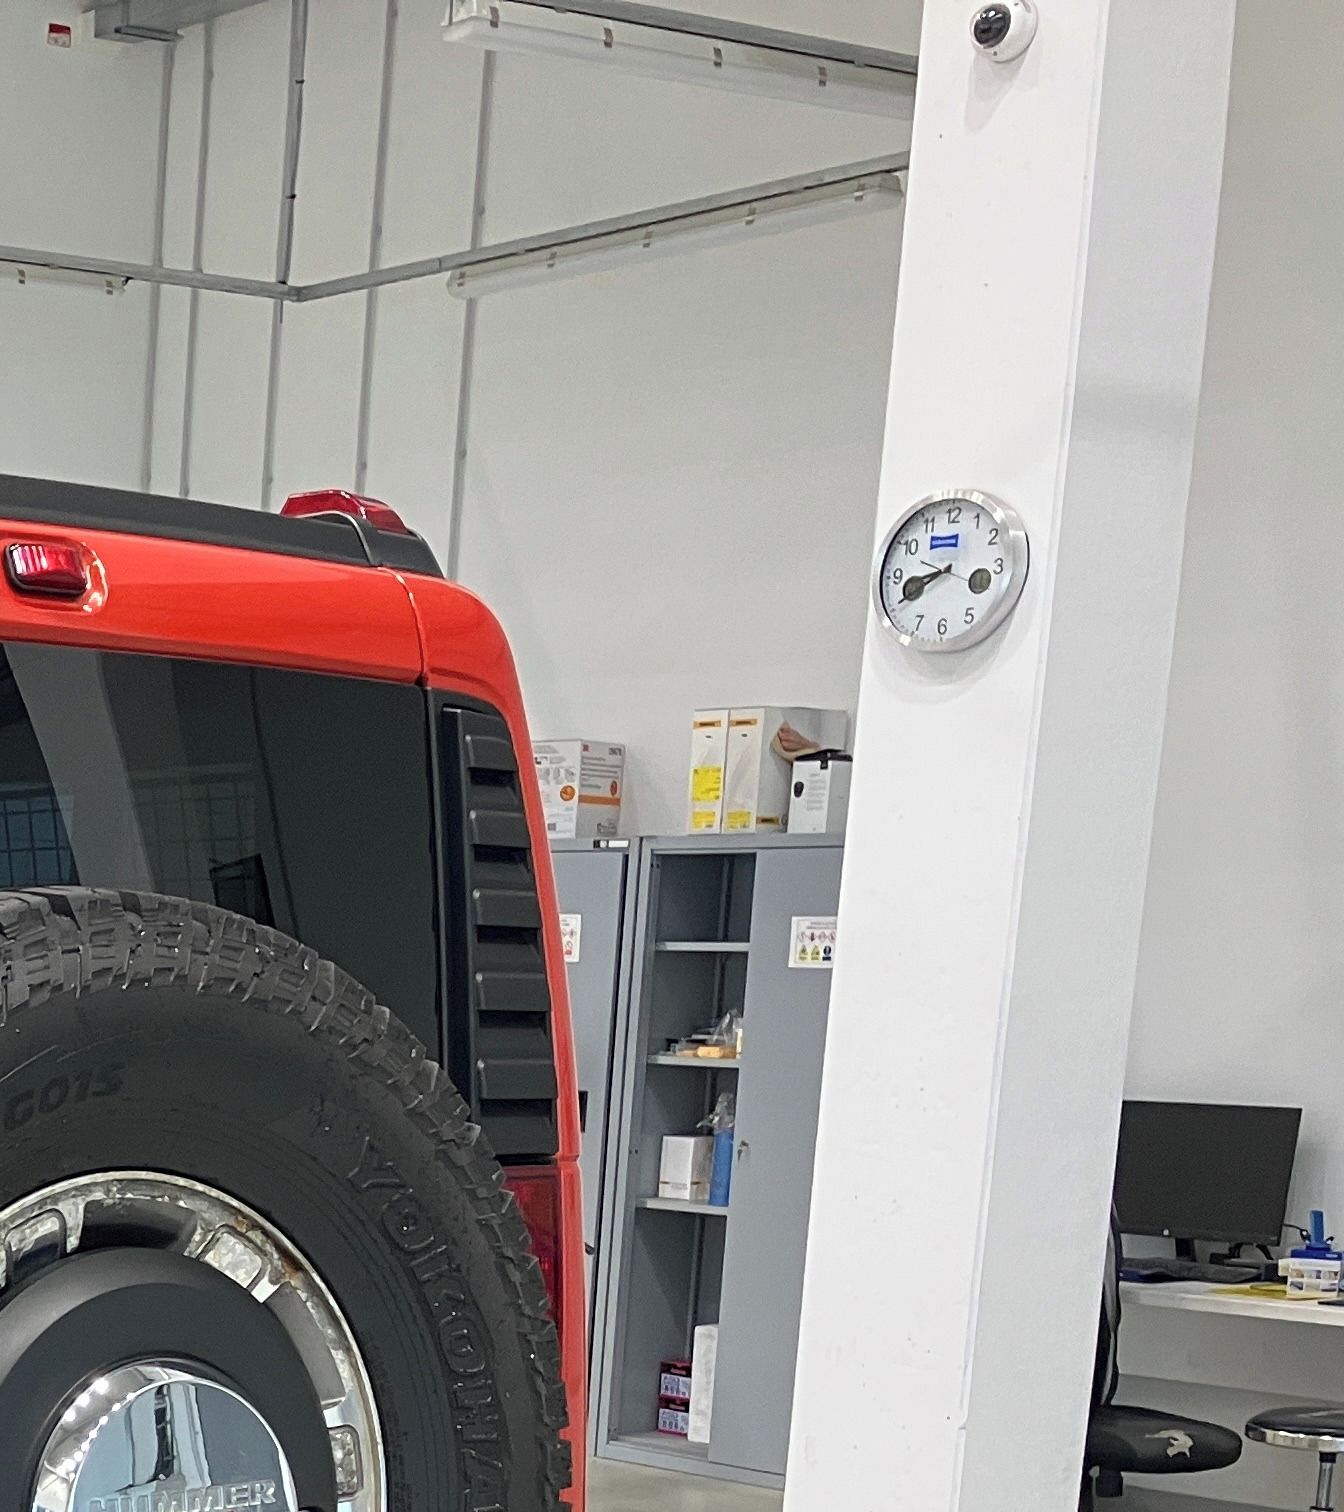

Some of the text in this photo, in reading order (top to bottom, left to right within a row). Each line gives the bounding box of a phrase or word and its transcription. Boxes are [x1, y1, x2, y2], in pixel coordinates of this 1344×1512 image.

[945, 506, 962, 524] 12
[973, 513, 981, 529] 1
[923, 516, 936, 534] 11
[987, 527, 999, 545] 2
[903, 538, 919, 556] 10
[993, 557, 1004, 575] 3
[892, 568, 904, 585] 9
[915, 614, 925, 632] 7
[963, 607, 975, 625] 5
[937, 618, 948, 636] 6
